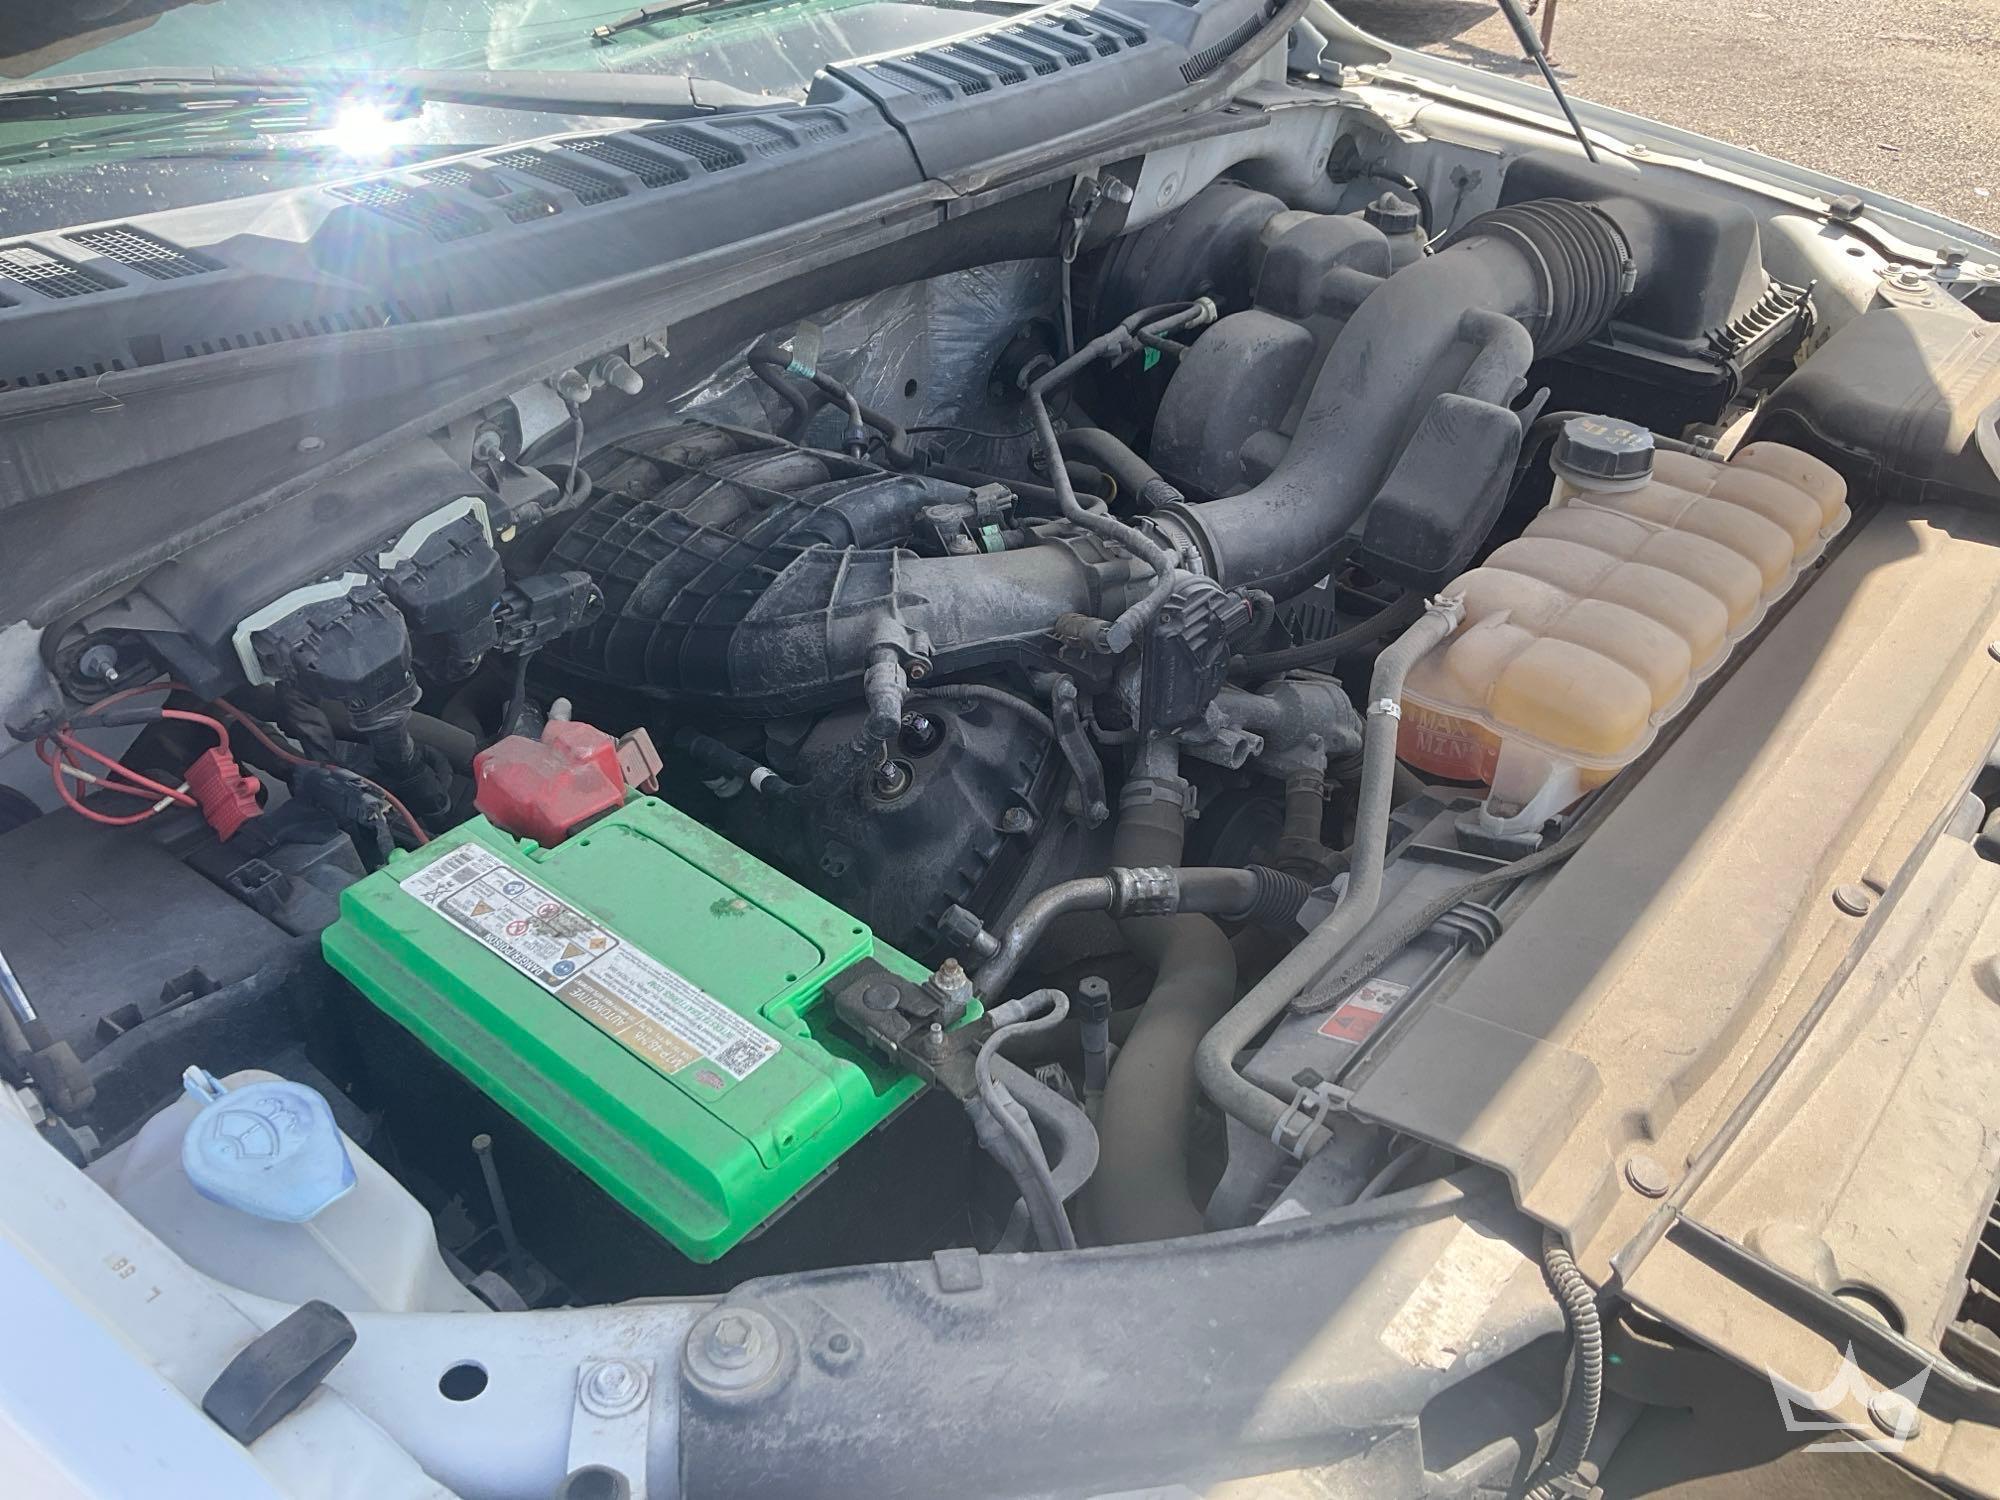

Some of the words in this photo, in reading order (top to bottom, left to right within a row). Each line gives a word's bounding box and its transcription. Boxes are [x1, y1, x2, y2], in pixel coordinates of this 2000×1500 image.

[1418, 710, 1469, 737] MAX
[483, 932, 544, 975] DANGER/POISON
[569, 986, 625, 1027] AUTOMOTIVE
